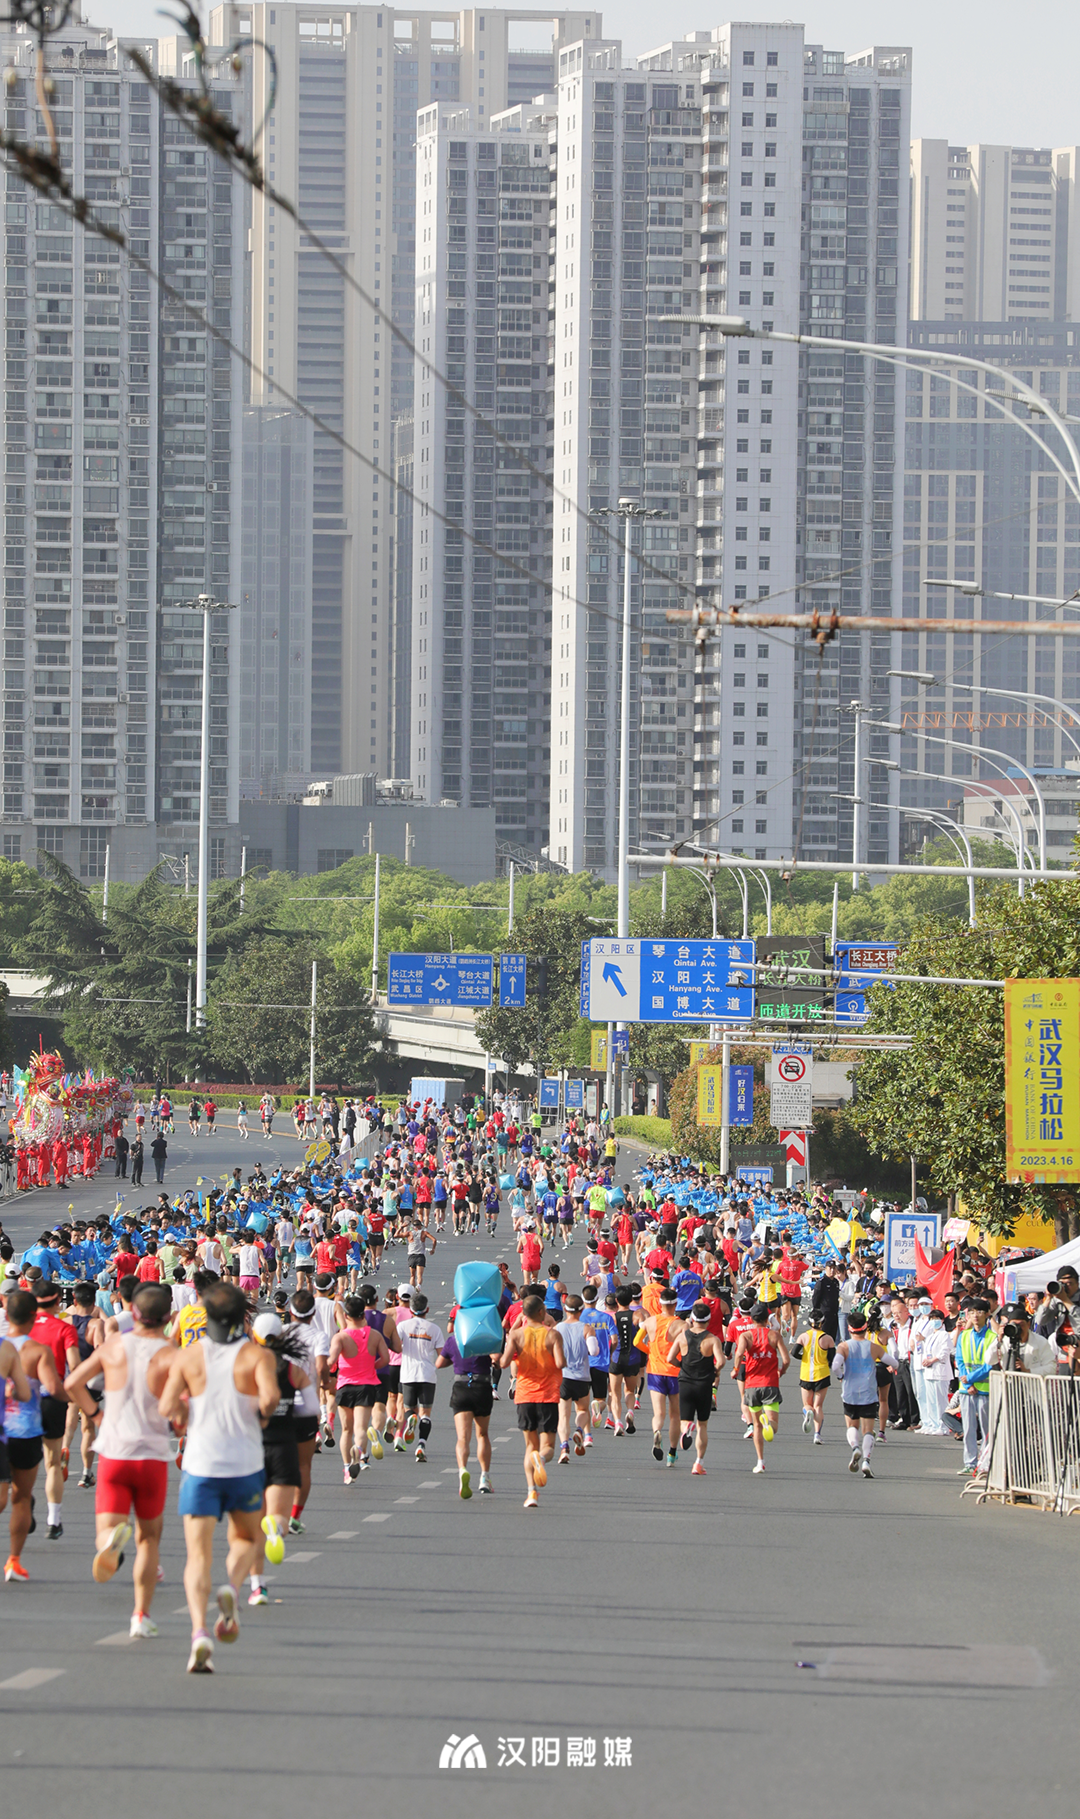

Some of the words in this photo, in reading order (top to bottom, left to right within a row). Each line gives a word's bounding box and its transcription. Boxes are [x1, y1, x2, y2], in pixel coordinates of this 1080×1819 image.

[595, 943, 635, 954] 汉阳区
[652, 944, 741, 960] 琴台大道
[425, 955, 457, 964] 汉阳大道
[851, 950, 897, 962] 长江大桥
[673, 959, 697, 967] Qintai
[700, 959, 718, 967] Ave.
[391, 969, 424, 978] 长江大桥
[458, 970, 490, 980] 琴台大道
[652, 970, 740, 984] 汉阳大道
[390, 984, 423, 994] 武昌区
[458, 986, 490, 994] 江城大道
[668, 985, 702, 994] Hanyang
[705, 985, 723, 993] Ave.
[652, 996, 740, 1011] 国博大道
[1024, 1018, 1036, 1080] 中国银行
[1039, 1018, 1063, 1140] 武汉马拉松
[1020, 1156, 1074, 1166] 2023.4.16
